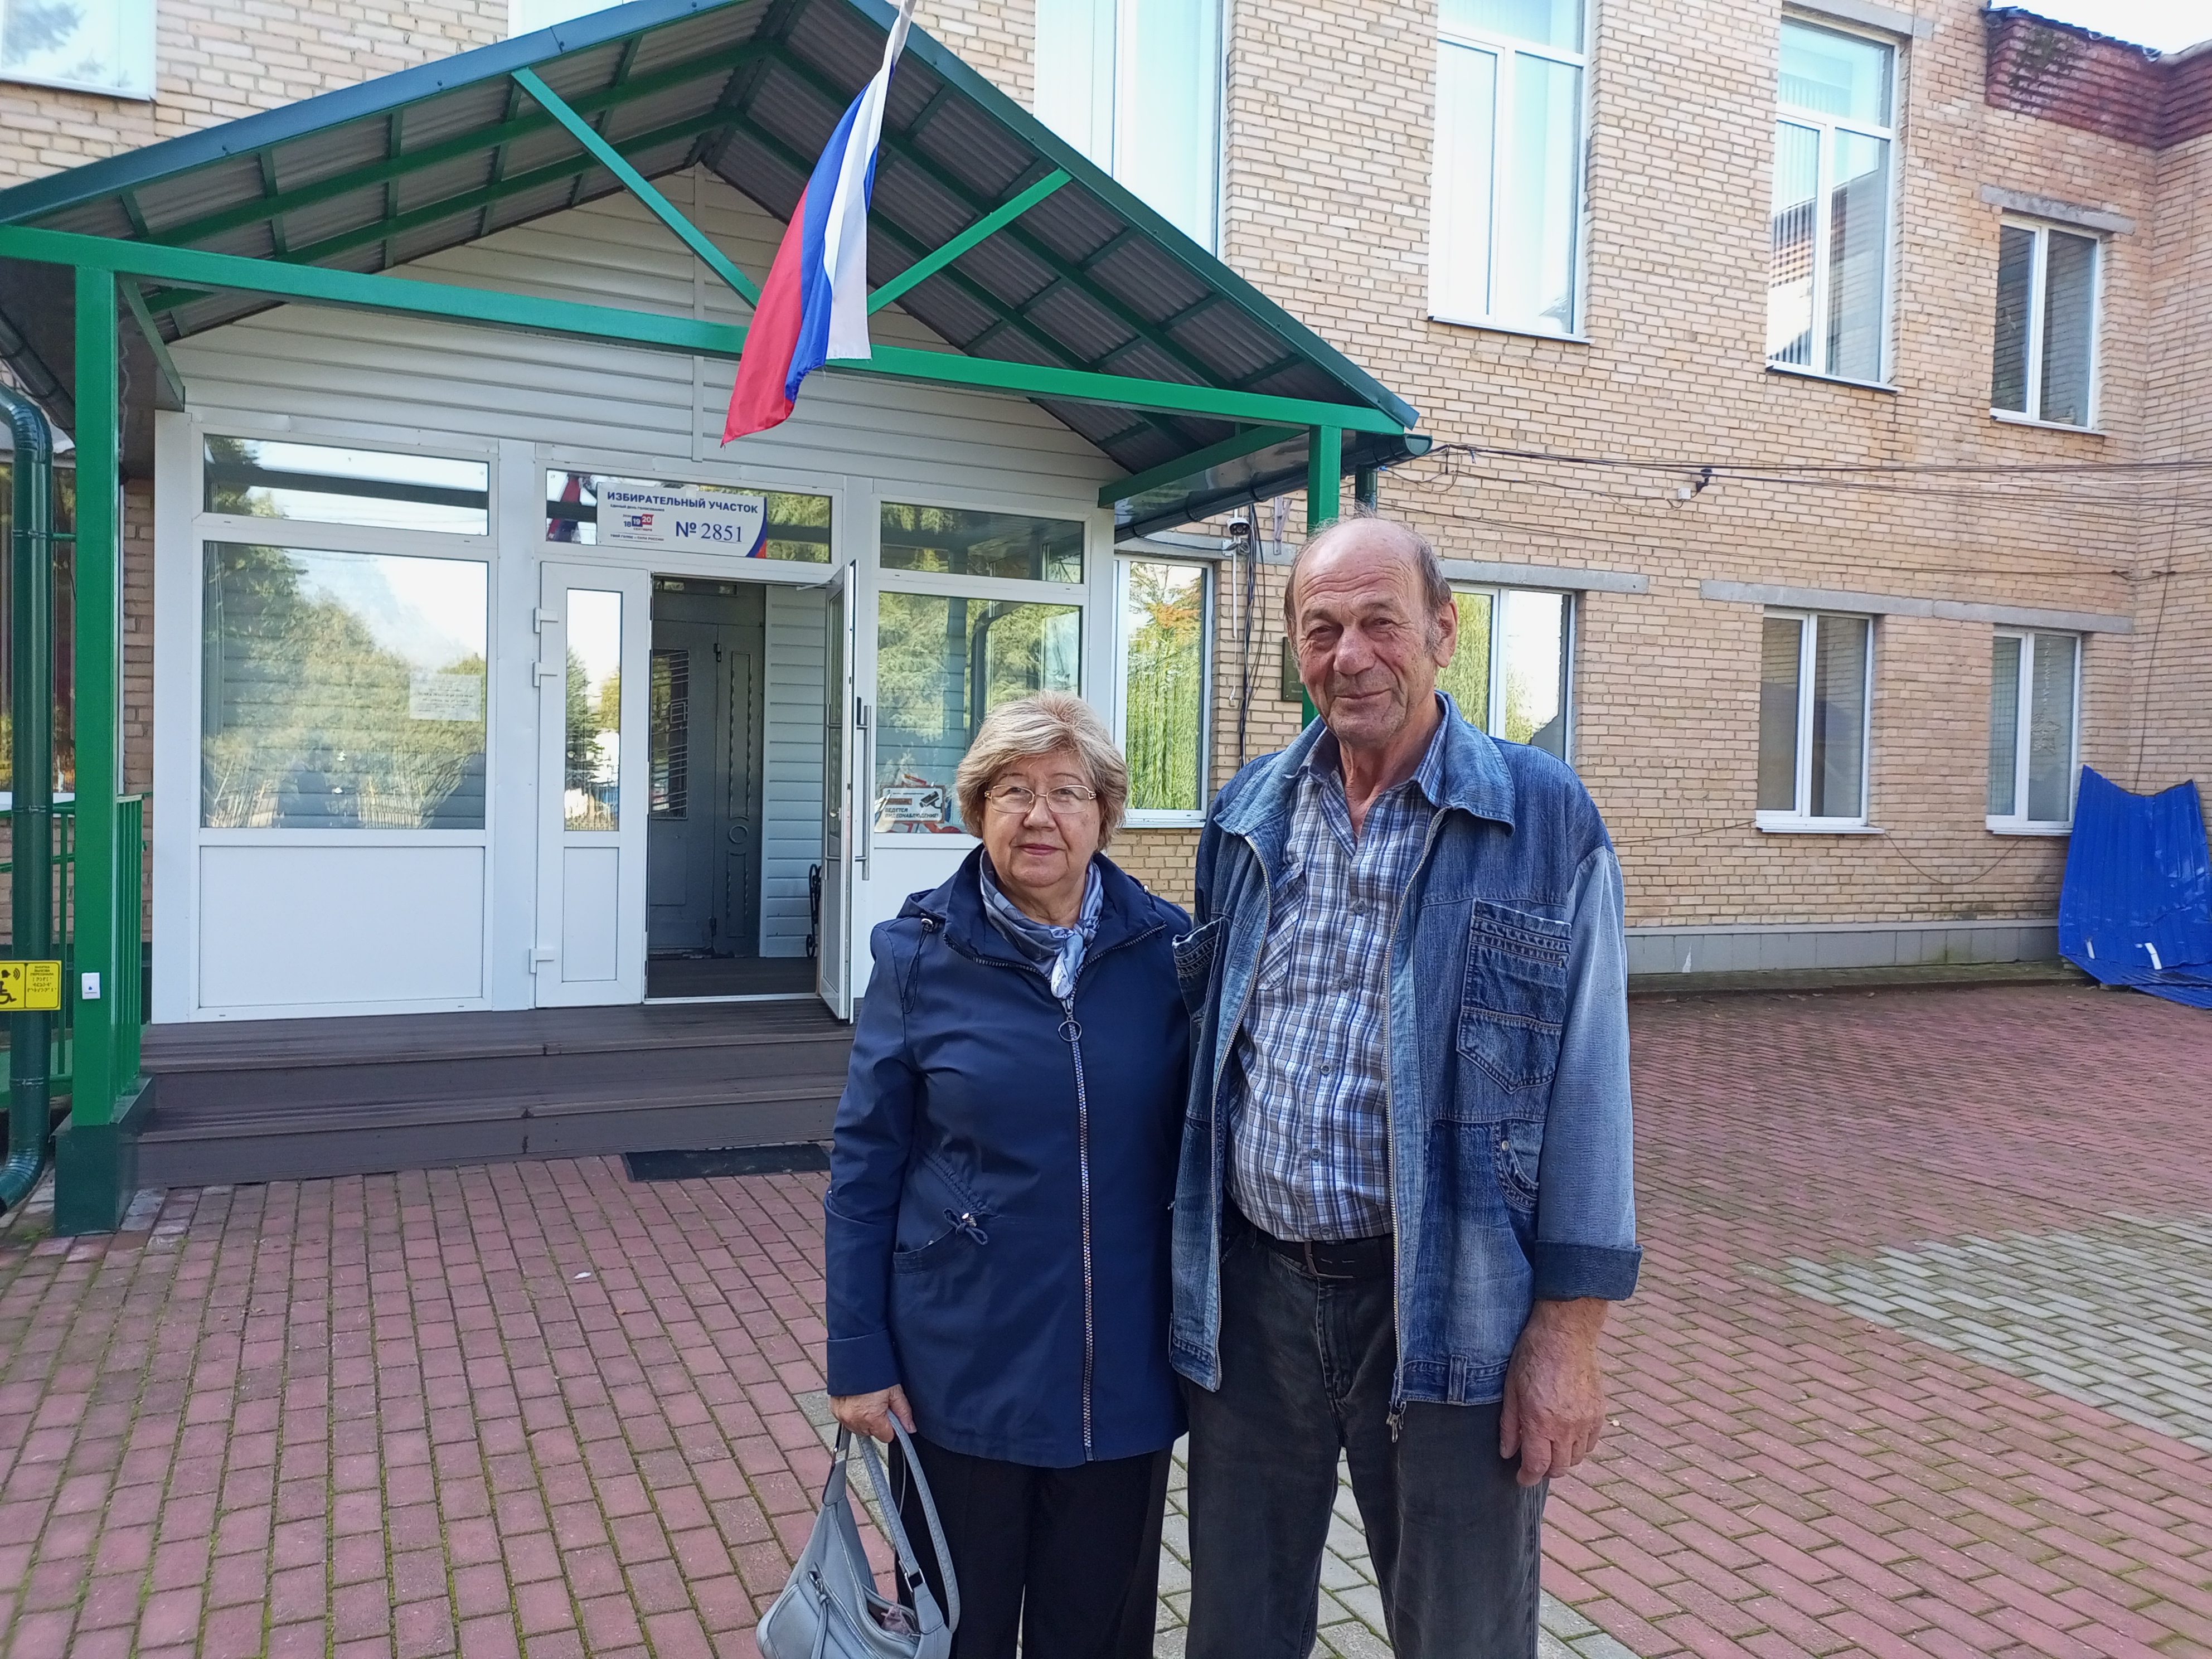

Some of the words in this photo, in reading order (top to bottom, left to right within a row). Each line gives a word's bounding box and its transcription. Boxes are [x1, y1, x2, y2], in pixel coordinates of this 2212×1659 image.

[607, 491, 706, 508] ИЗБИРАТЕЛЬНЫЙ
[709, 501, 758, 513] УЧАСТОК
[676, 521, 697, 537] №
[701, 522, 742, 542] 2851
